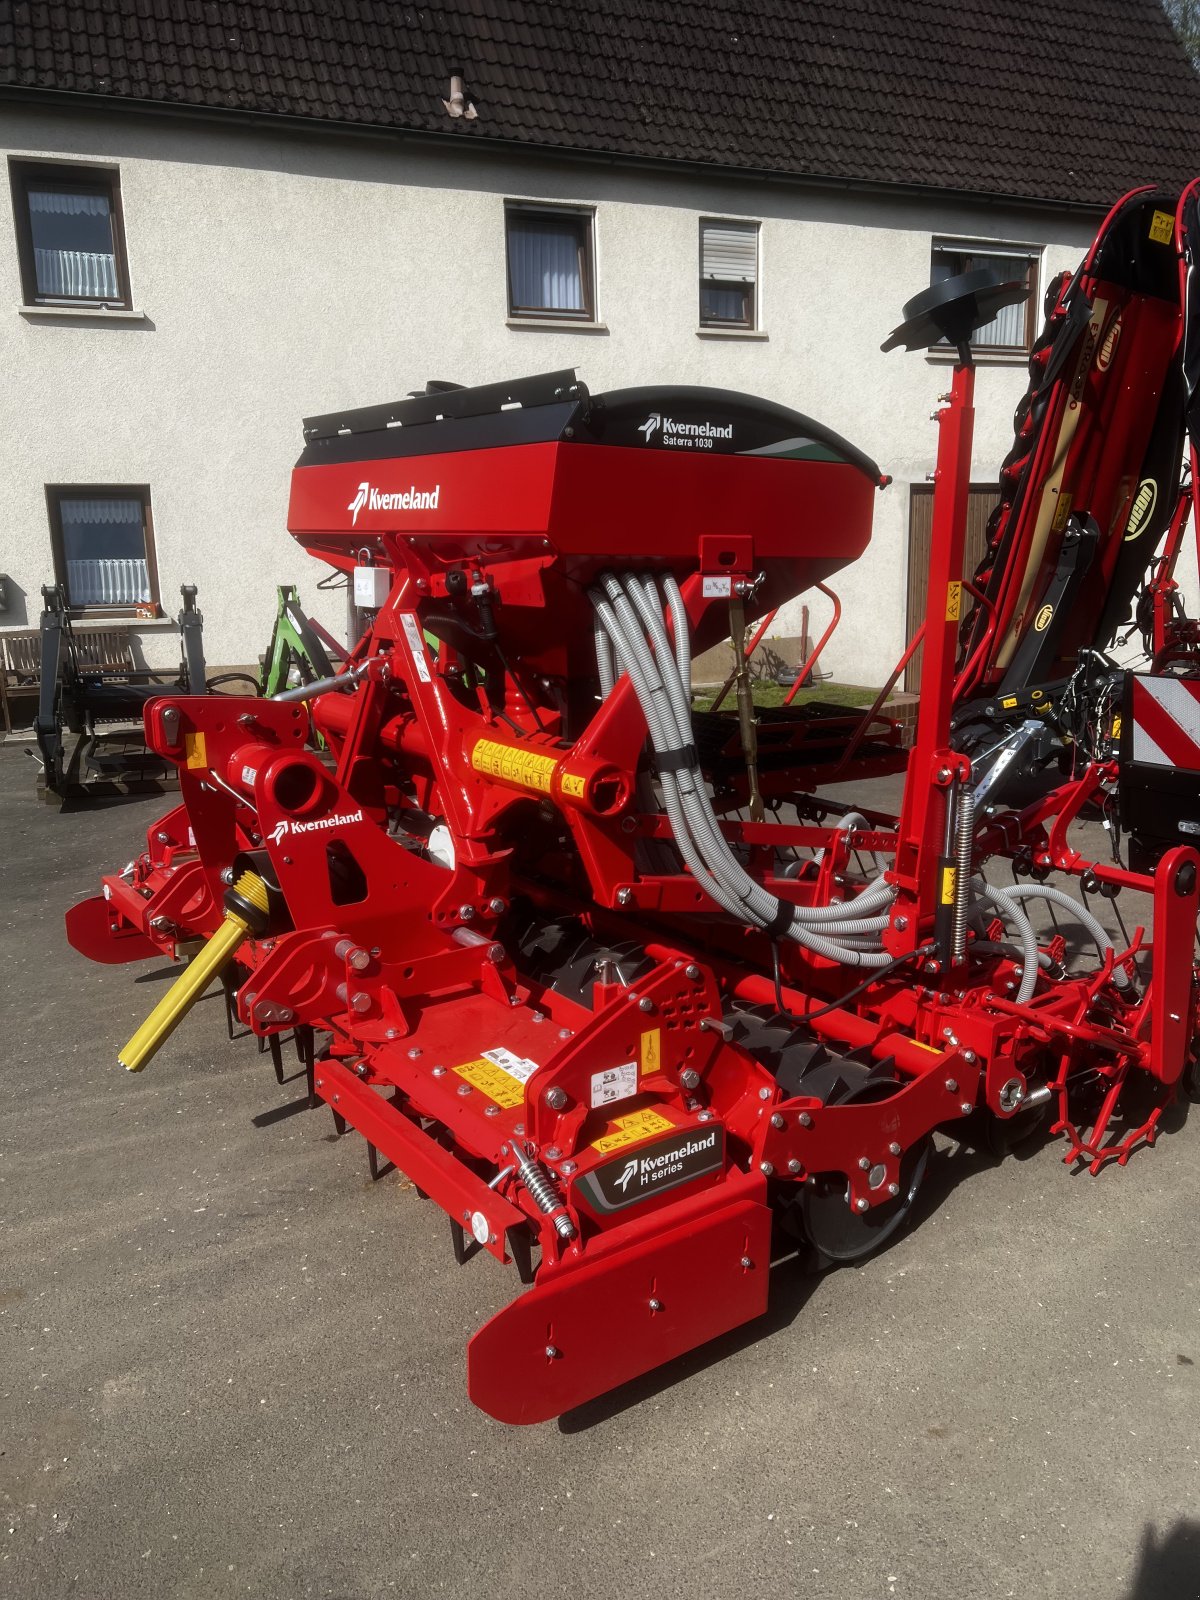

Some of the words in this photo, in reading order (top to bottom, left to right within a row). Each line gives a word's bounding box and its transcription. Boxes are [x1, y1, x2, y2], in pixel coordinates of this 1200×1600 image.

[663, 418, 733, 439] Kverneland
[663, 435, 692, 447] Saterra
[695, 438, 713, 448] 1030
[369, 484, 440, 510] Kverneland
[291, 810, 363, 834] Kverneland
[640, 1132, 715, 1173] Kverneland
[640, 1173, 649, 1186] H
[651, 1162, 683, 1181] series
